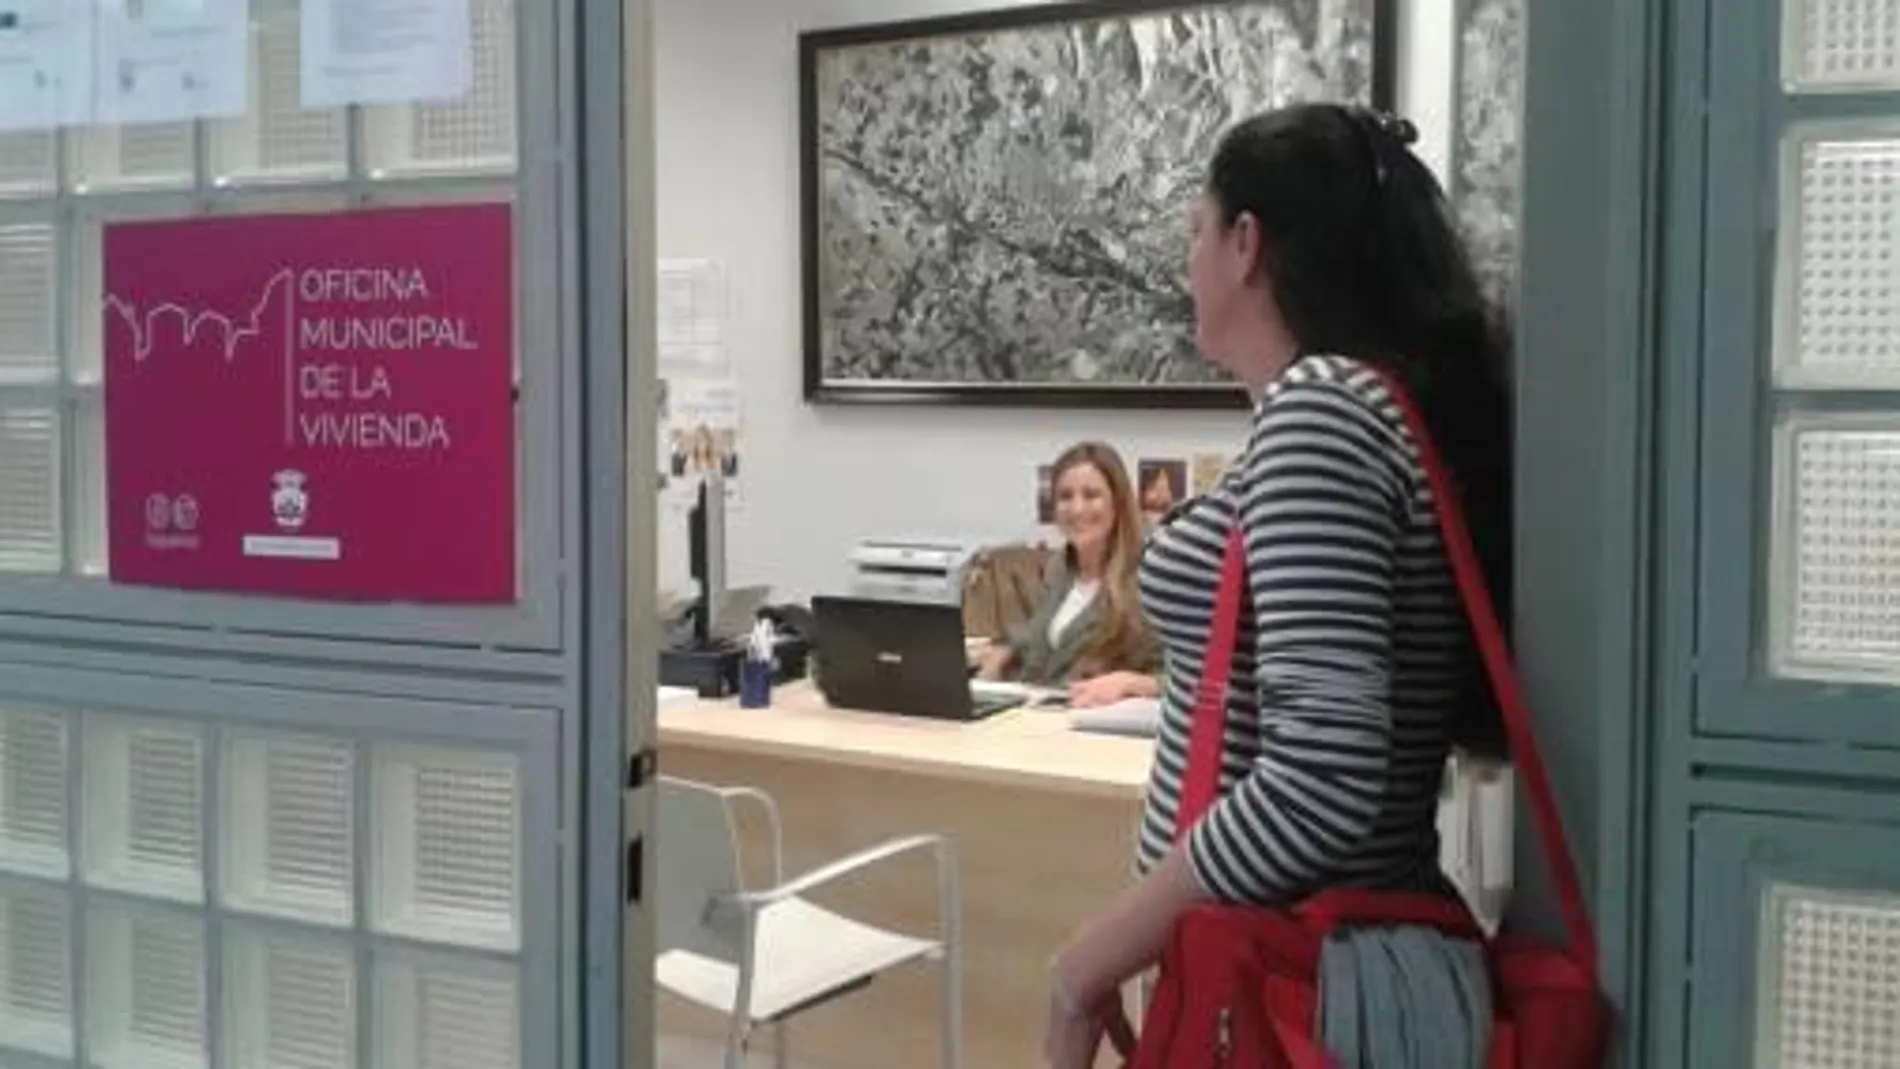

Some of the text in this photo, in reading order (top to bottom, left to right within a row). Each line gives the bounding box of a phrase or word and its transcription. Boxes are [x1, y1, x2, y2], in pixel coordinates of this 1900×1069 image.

[301, 268, 427, 302] OFICINA
[300, 316, 478, 350] MUNICIPAL
[300, 366, 391, 399] DE LA
[300, 413, 450, 449] VIVIENDA
